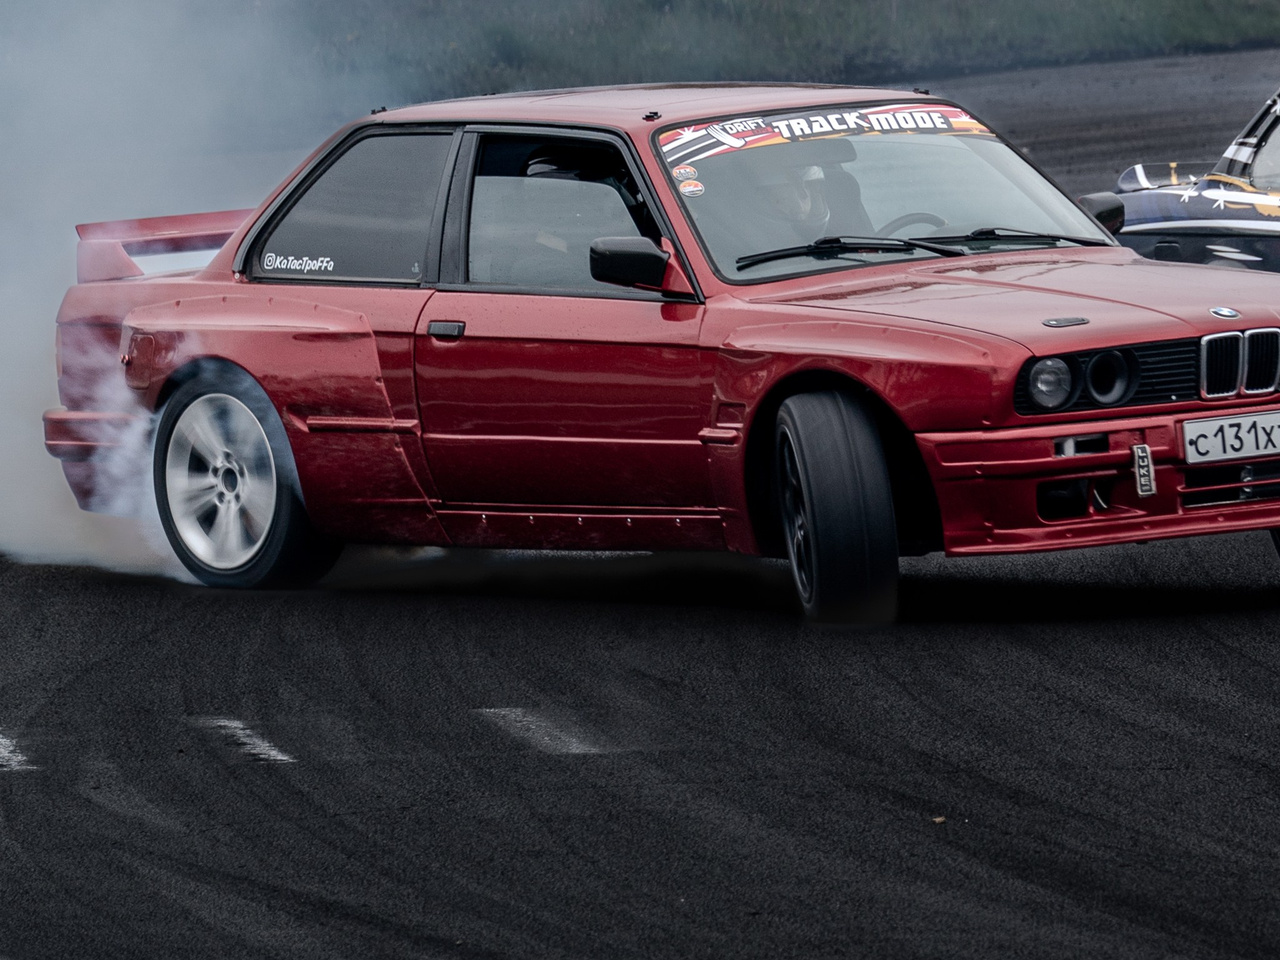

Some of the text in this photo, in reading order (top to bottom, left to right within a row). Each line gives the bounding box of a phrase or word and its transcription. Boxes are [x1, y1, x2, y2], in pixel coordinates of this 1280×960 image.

[724, 119, 767, 135] DRIFT
[772, 111, 868, 139] TRACK
[868, 111, 948, 132] MODE
